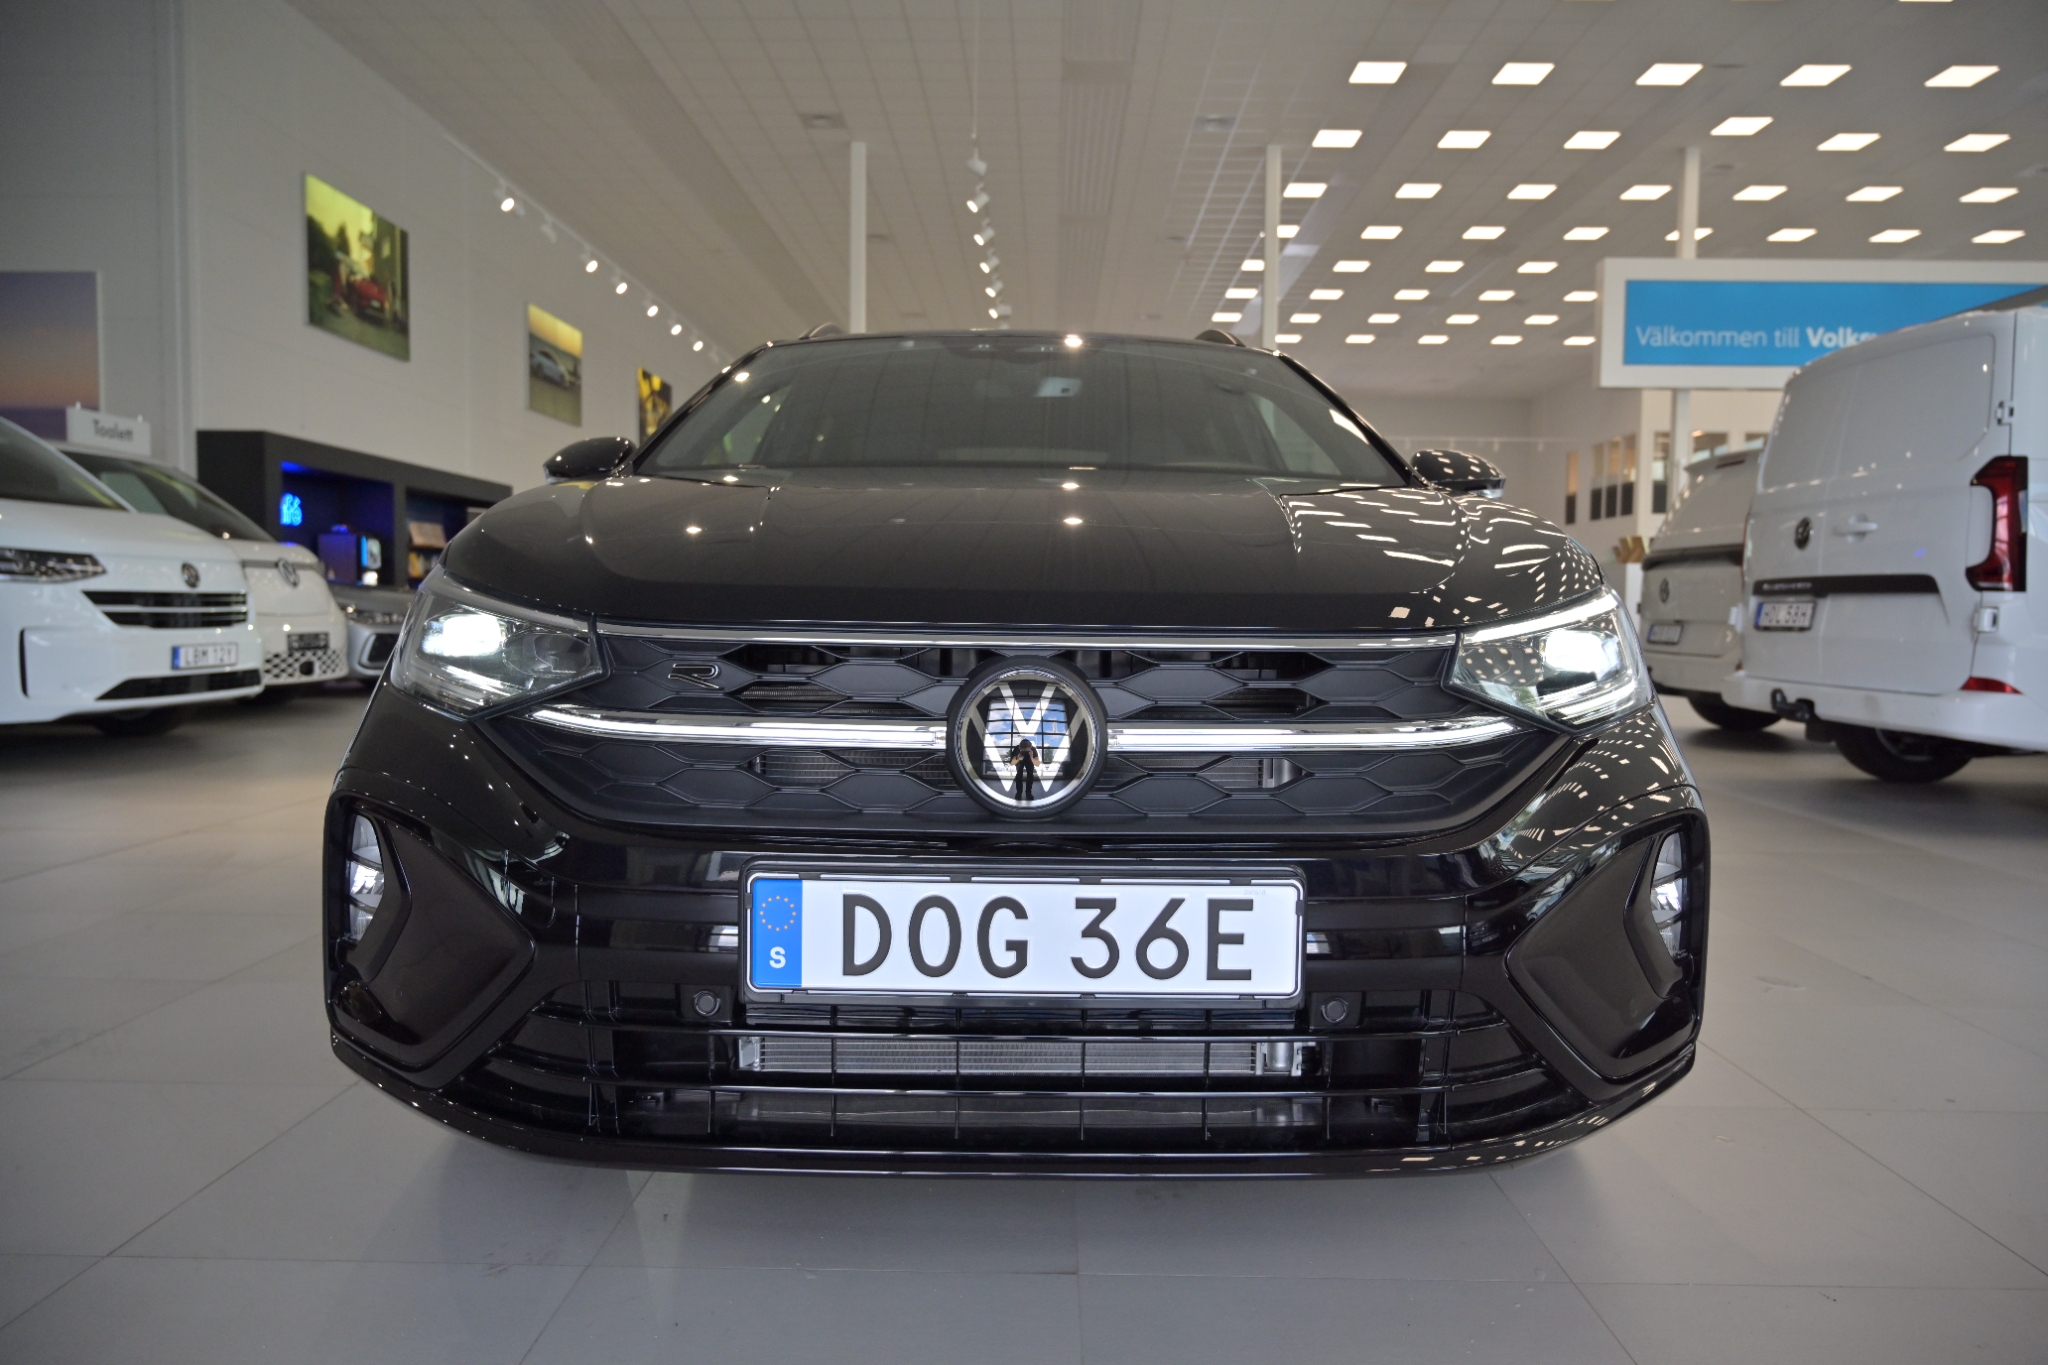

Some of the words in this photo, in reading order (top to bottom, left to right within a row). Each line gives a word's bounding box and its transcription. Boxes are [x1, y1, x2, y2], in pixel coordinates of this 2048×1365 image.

[1636, 325, 1767, 347] Välkommen
[1774, 326, 1800, 348] till
[93, 419, 133, 441] Toalett
[667, 663, 720, 690] R
[958, 670, 1098, 802] VW
[769, 946, 786, 969] S
[842, 892, 1029, 979] DOG
[1070, 896, 1255, 981] 36E
